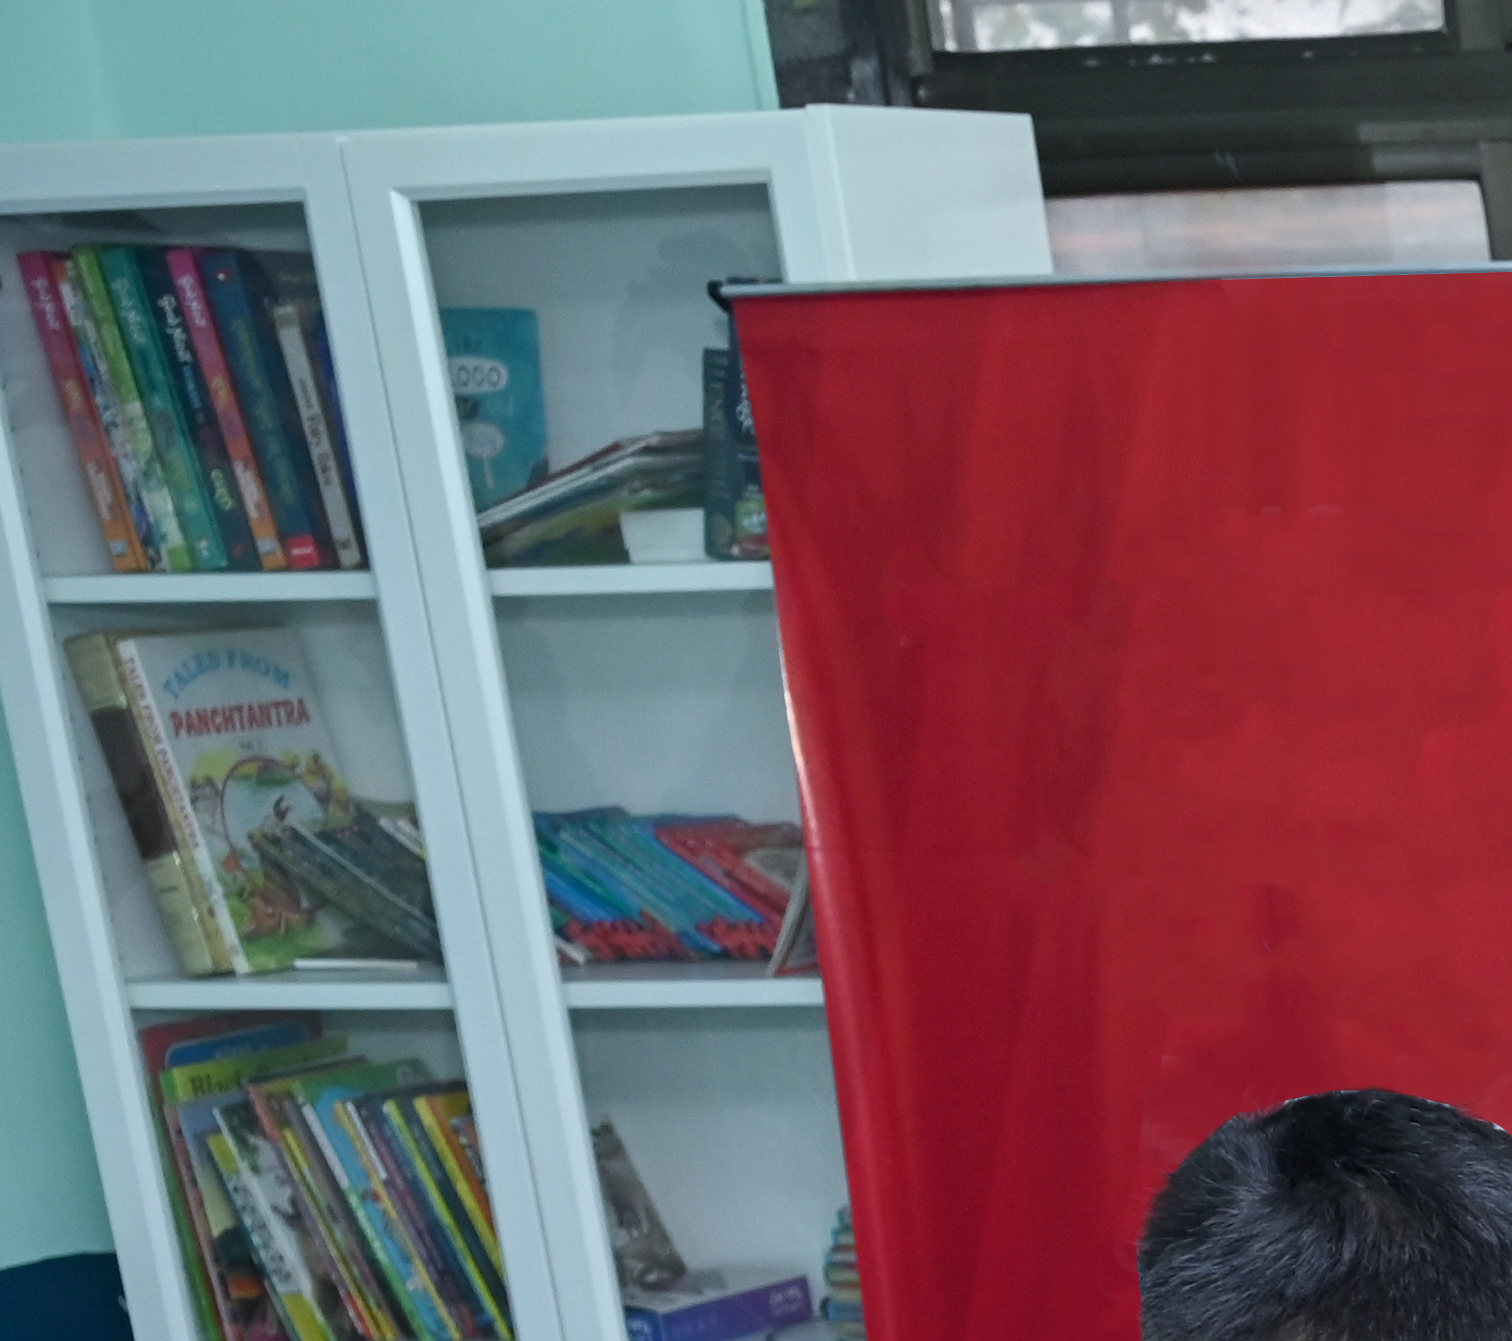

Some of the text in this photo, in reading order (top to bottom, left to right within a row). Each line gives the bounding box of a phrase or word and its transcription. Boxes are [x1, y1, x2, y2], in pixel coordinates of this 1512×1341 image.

[163, 647, 291, 700] TALES FROM
[169, 698, 311, 738] PANCHTANTRA
